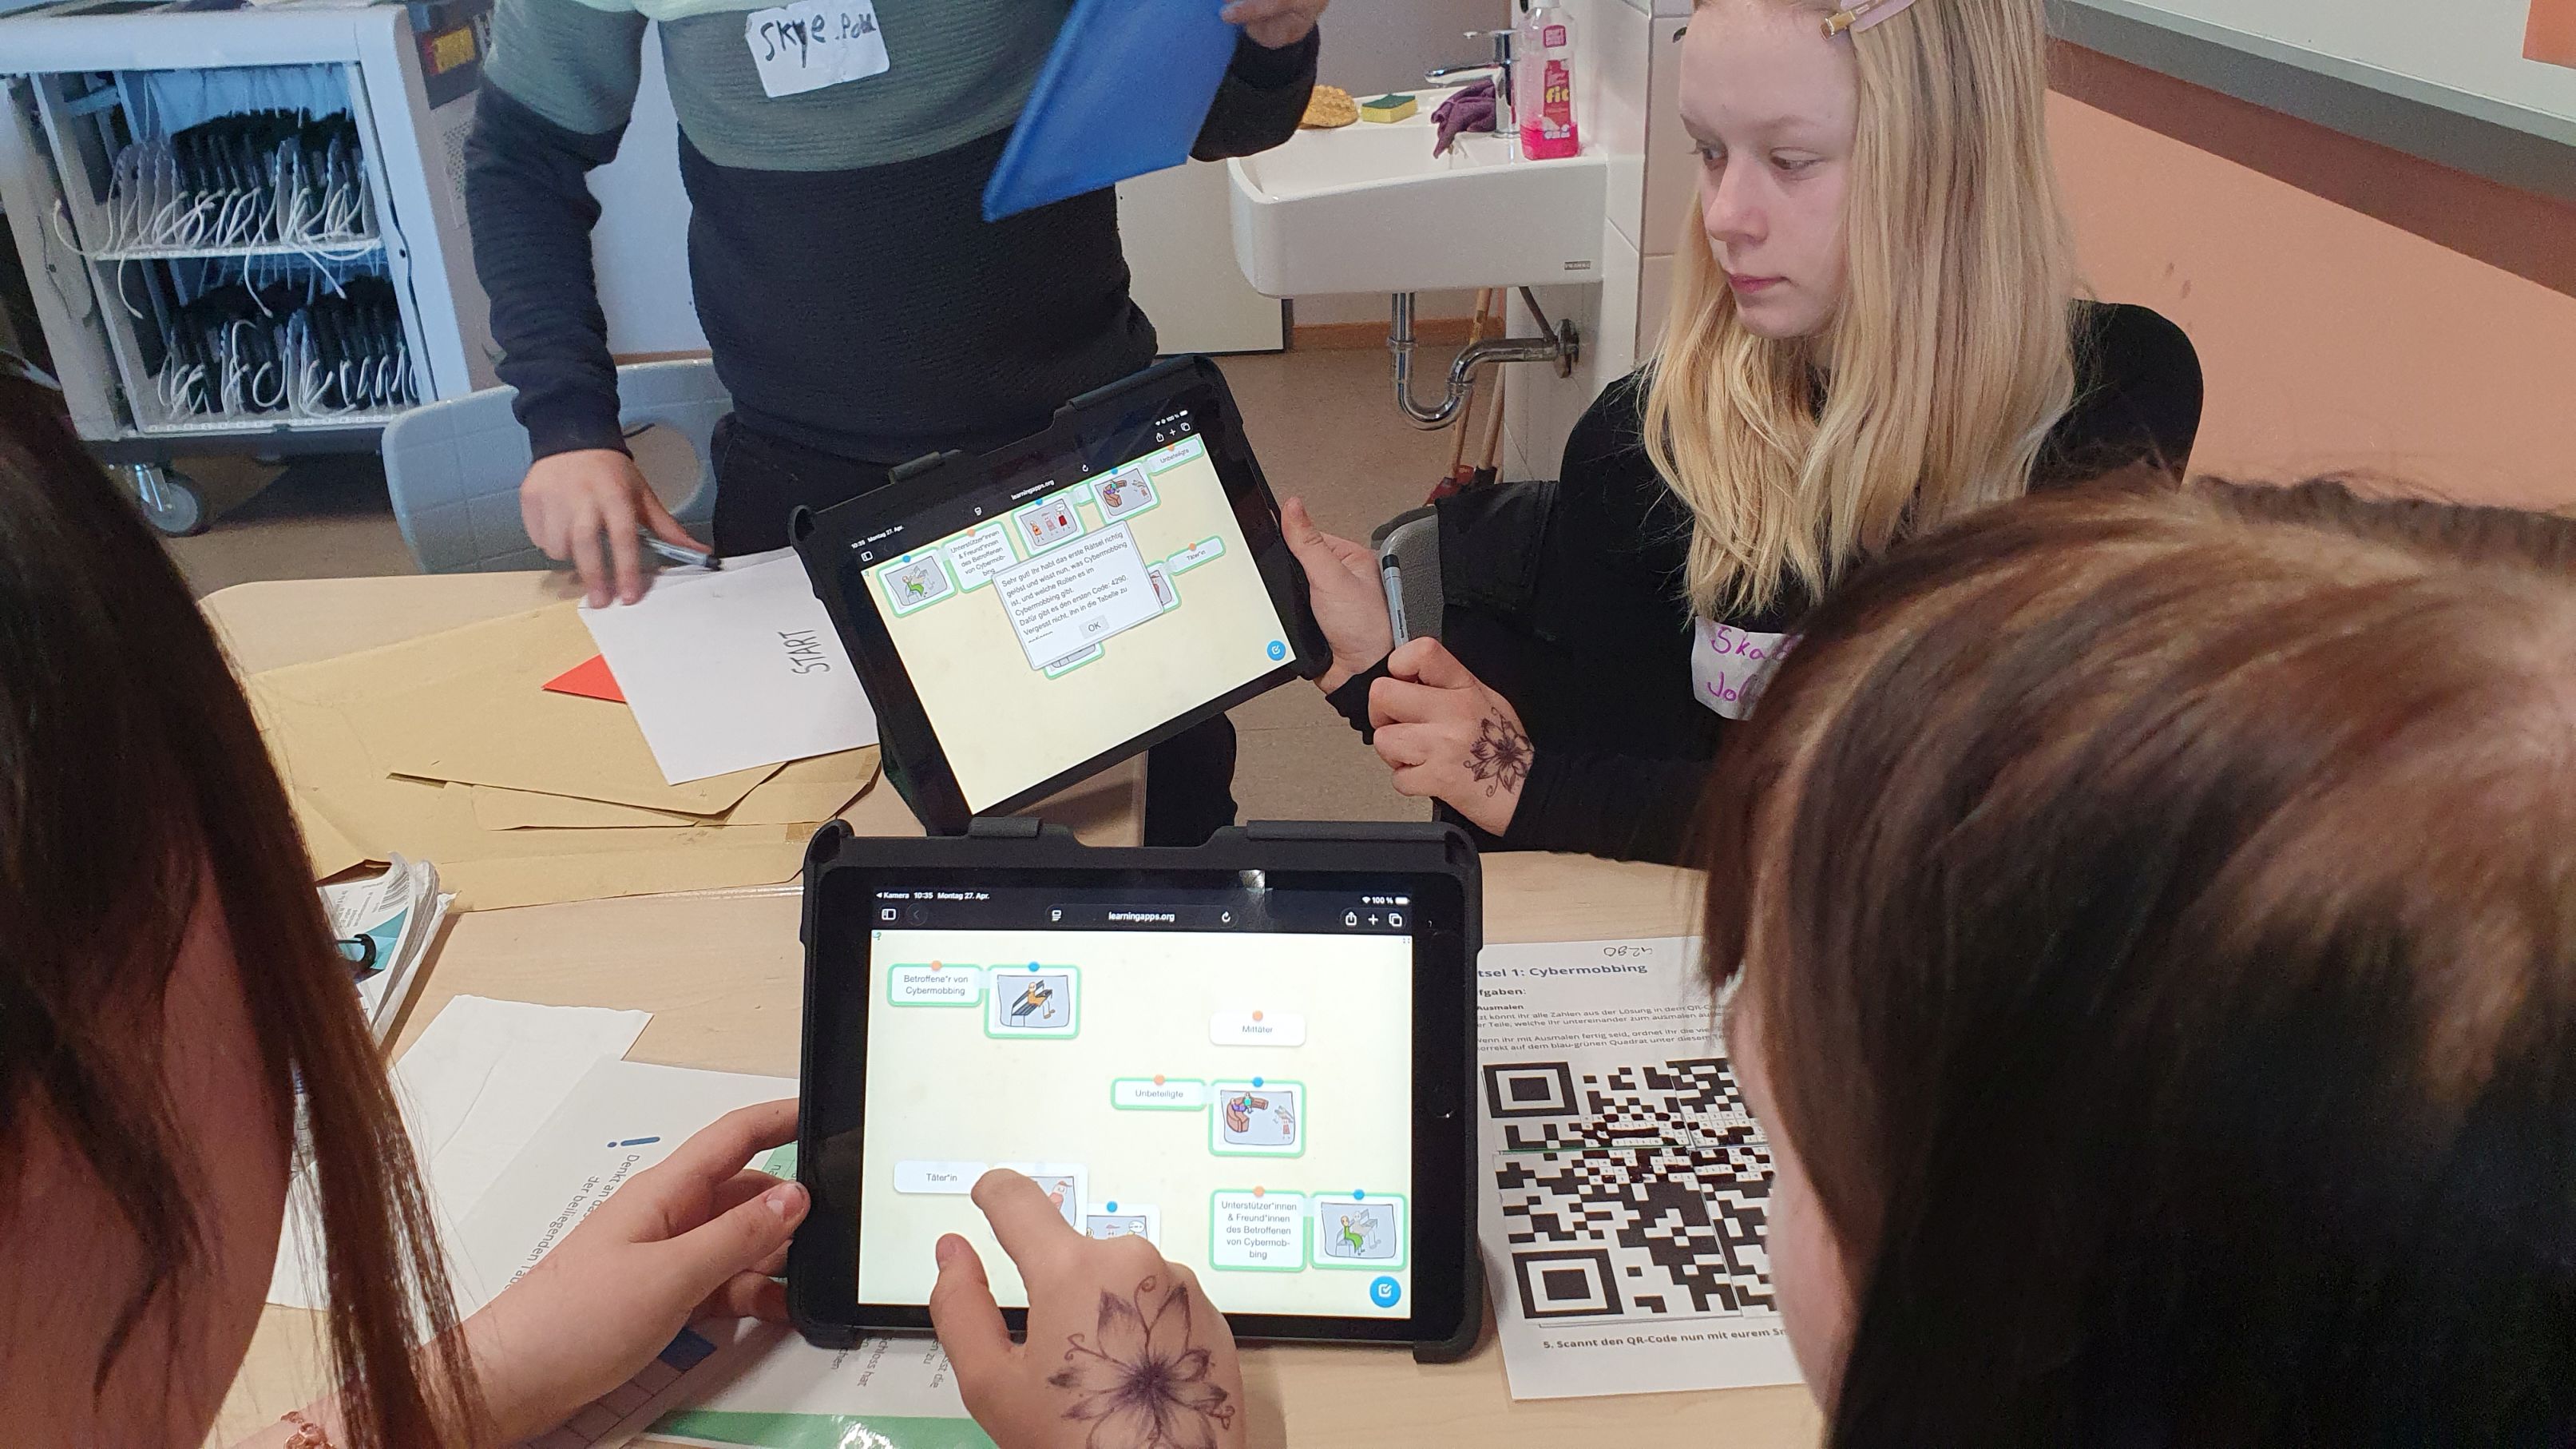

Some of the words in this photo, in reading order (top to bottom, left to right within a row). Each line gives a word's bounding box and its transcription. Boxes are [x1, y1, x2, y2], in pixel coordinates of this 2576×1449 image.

[760, 14, 826, 69] Skye
[1546, 85, 1569, 103] fit
[1011, 479, 1055, 501] learningapps.org
[1001, 577, 1017, 587] Sehr
[1040, 561, 1056, 572] habt
[1056, 555, 1068, 564] das
[1068, 549, 1084, 559] erste
[1084, 540, 1104, 553] Rätsel
[1104, 532, 1124, 545] richtig
[1007, 586, 1026, 597] gelöst
[1027, 579, 1039, 589] und
[1040, 573, 1056, 583] wisst
[1084, 542, 1127, 565] Cybermobbing
[1022, 592, 1034, 602] und
[1035, 584, 1056, 597] welche
[1056, 574, 1076, 587] Rollen
[1015, 593, 1060, 617] Cybermobbing
[1019, 614, 1037, 626] Dafür
[1038, 607, 1051, 619] gibt
[1060, 598, 1072, 609] den
[1072, 591, 1092, 603] ersten
[1092, 582, 1111, 594] Code:
[1023, 620, 1052, 636] Vergesst
[1069, 607, 1080, 616] ihn
[1087, 599, 1097, 608] die
[1097, 591, 1120, 603] Tabelle
[1088, 621, 1101, 632] OK
[777, 630, 831, 674] START
[1108, 911, 1175, 922] learningapps.org
[1478, 968, 1507, 978] tsel
[1511, 968, 1525, 977] 1:
[1529, 963, 1648, 978] Cybermobbing
[906, 987, 965, 996] Cybermobbing
[1479, 989, 1527, 998] fgaben:
[1563, 1015, 1627, 1025] untereinander
[1135, 1090, 1183, 1099] Unbeteiligte
[608, 1154, 640, 1183] Denkt
[581, 1176, 600, 1193] der
[602, 1184, 614, 1197] an
[528, 1195, 588, 1261] beiliegenden
[1243, 1225, 1291, 1235] Betroffenen
[1243, 1237, 1290, 1247] Cybermob-
[1249, 1250, 1267, 1260] bing
[1556, 1339, 1598, 1348] Scannt
[1601, 1337, 1623, 1346] den
[1627, 1335, 1678, 1345] QR-Code
[1707, 1331, 1728, 1340] mit
[1730, 1329, 1770, 1339] eurem
[923, 1353, 935, 1364] zu
[857, 1371, 874, 1387] hat
